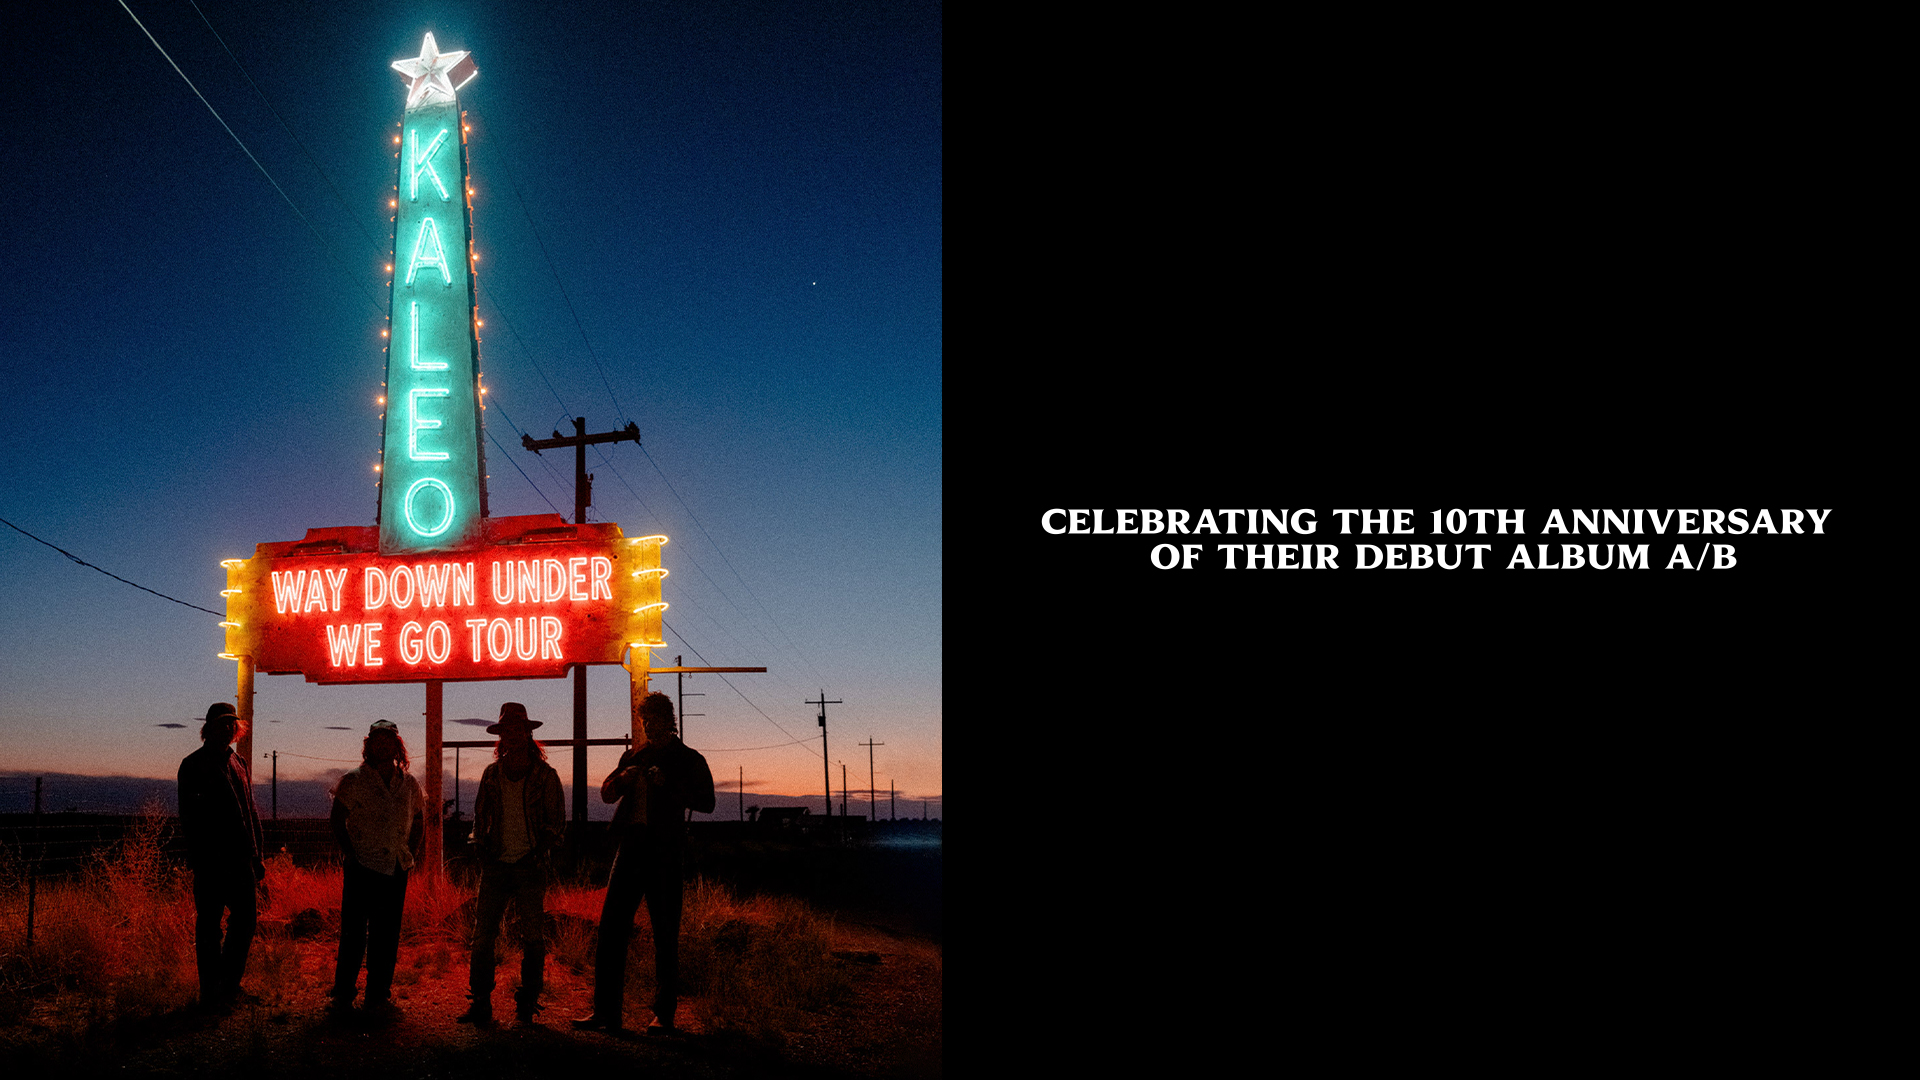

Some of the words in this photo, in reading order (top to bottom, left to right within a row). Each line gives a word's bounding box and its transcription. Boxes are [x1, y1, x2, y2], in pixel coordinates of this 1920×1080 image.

[404, 128, 455, 538] KALEO
[271, 568, 348, 614] WAY
[364, 562, 475, 610] DOWN
[492, 556, 613, 605] UNDER
[326, 622, 383, 667] WE
[400, 620, 452, 665] GO
[466, 616, 563, 662] TOUR
